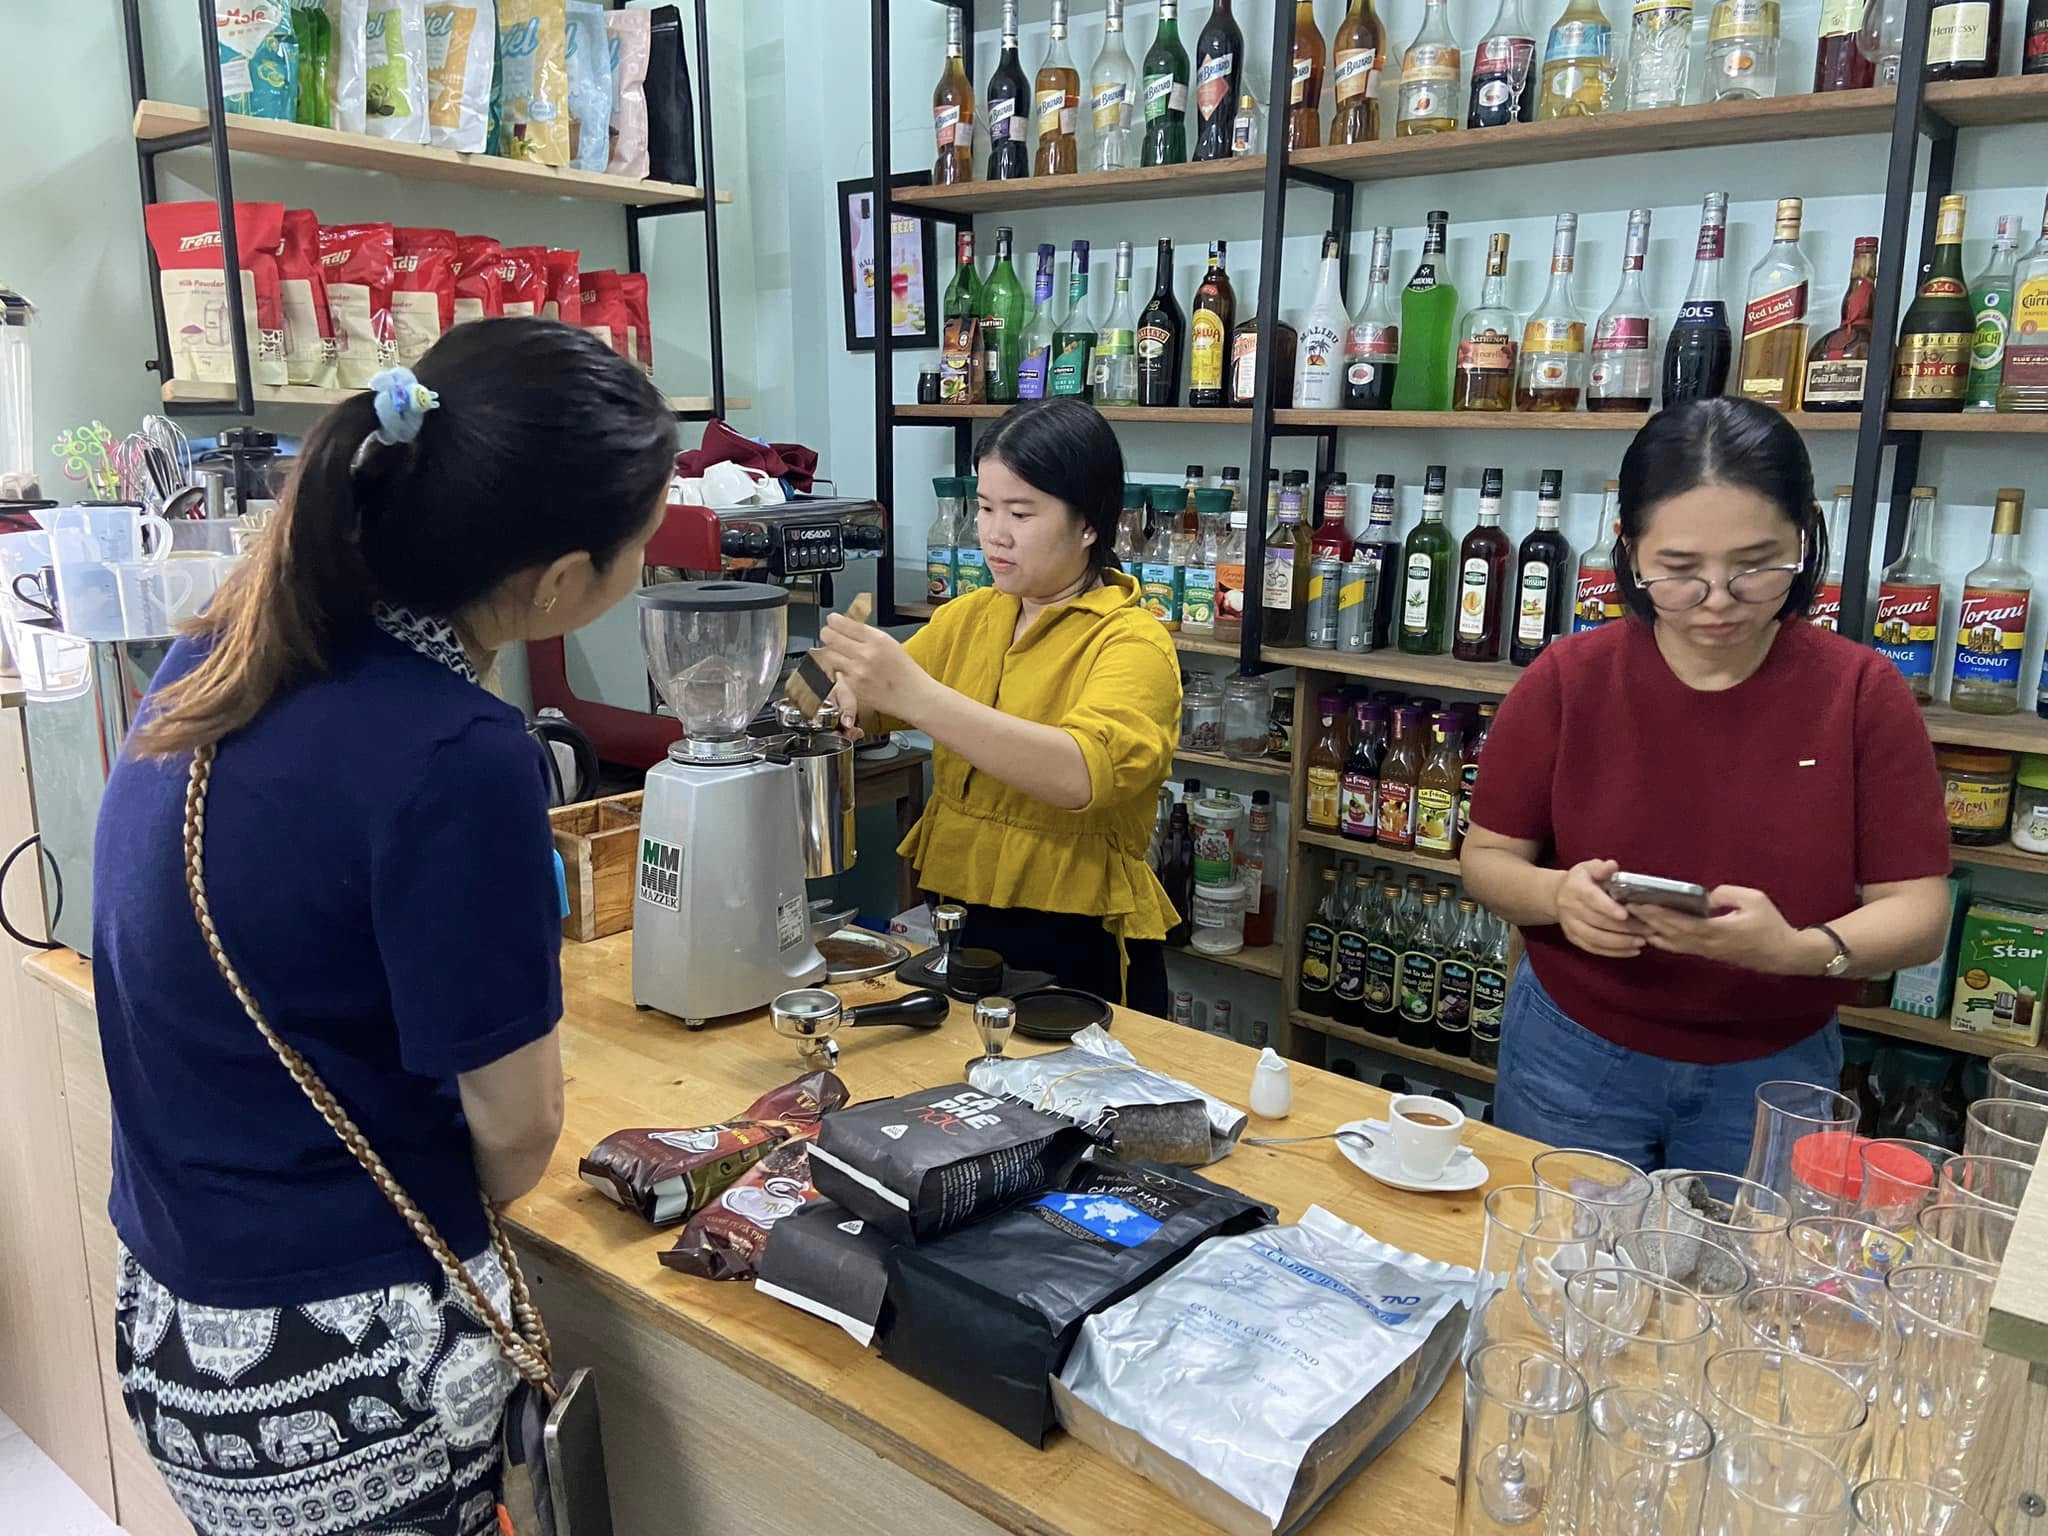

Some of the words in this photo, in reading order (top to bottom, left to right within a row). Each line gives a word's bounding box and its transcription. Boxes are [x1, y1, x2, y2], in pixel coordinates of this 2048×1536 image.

[1933, 23, 1978, 38] Hennessy
[1203, 59, 1230, 79] BRIZARD
[1747, 308, 1767, 322] Red
[1768, 298, 1795, 312] Label
[1299, 326, 1340, 344] MALIBU
[800, 529, 832, 540] CASADIO
[1577, 576, 1617, 601] Toran
[1876, 595, 1932, 624] Torani
[1960, 598, 2026, 630] Torani
[1958, 652, 2009, 667] COCONUT
[640, 887, 679, 909] MAZZER
[1993, 945, 2043, 958] Star
[1380, 1295, 1421, 1306] TND
